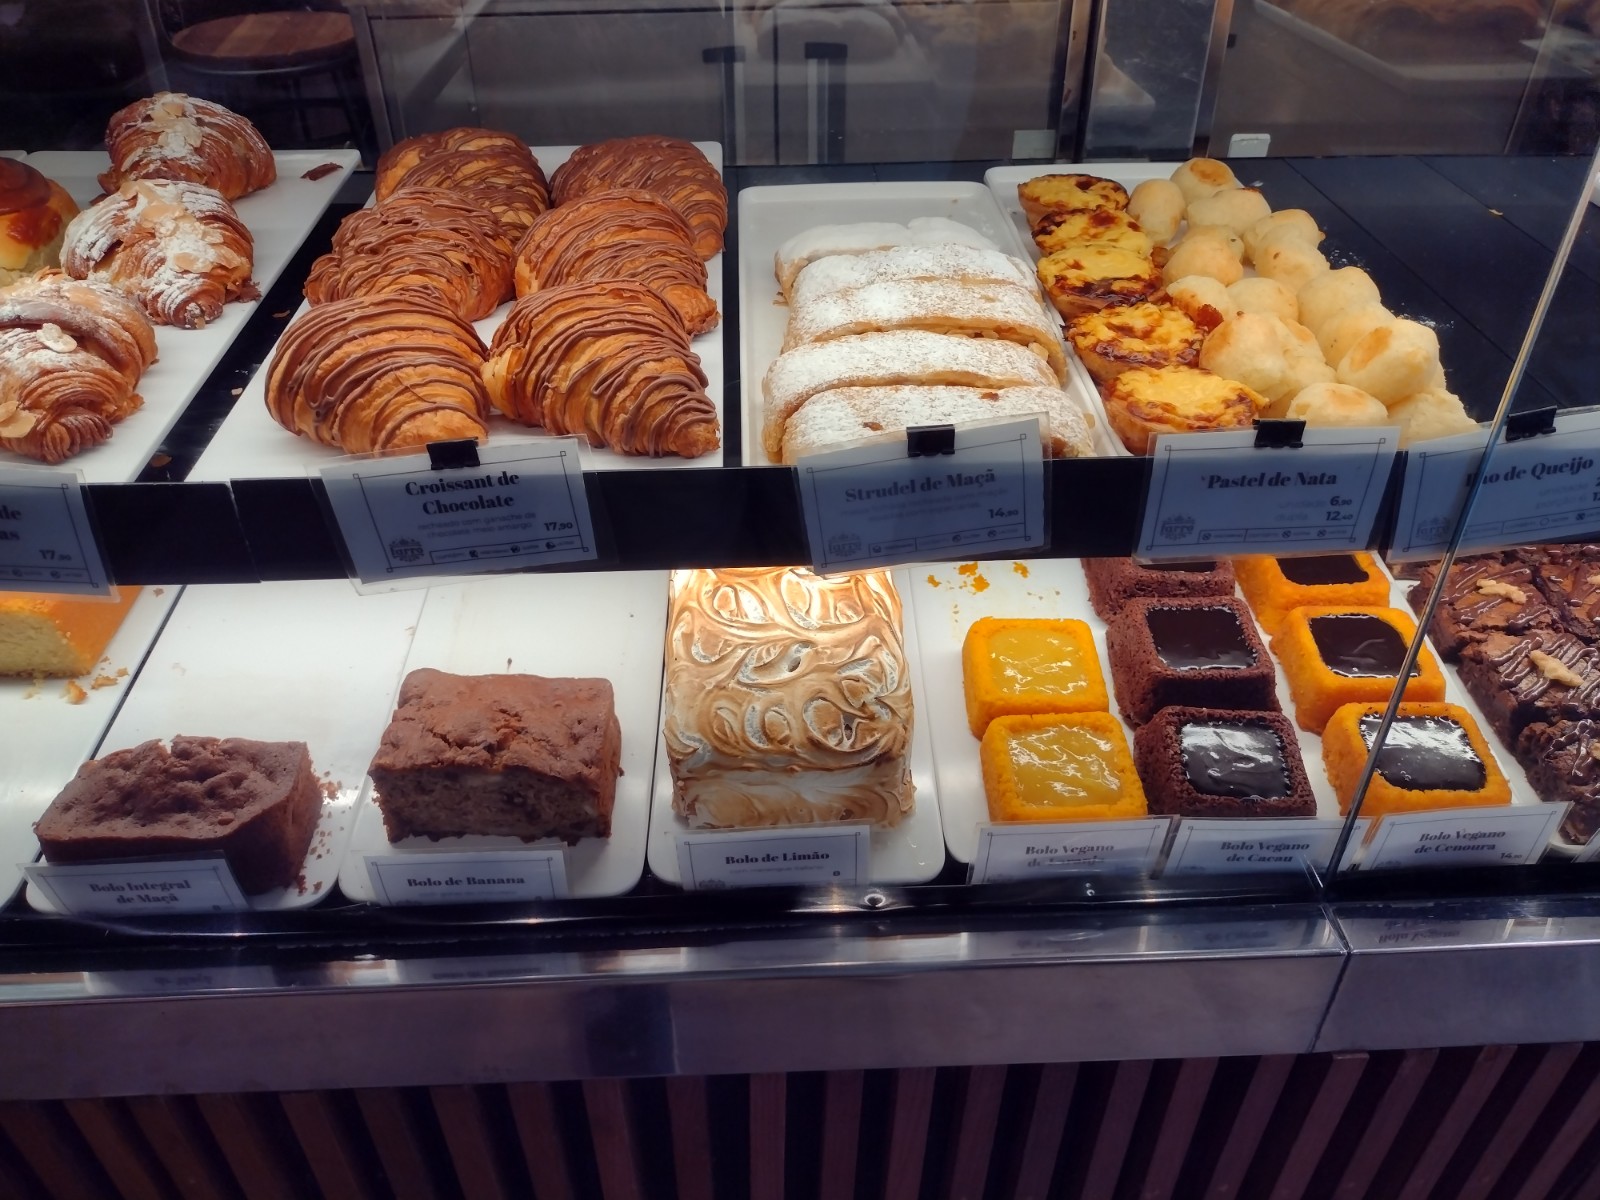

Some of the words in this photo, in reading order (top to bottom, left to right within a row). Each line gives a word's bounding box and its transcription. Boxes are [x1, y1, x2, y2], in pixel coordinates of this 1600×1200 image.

[1504, 466, 1527, 481] de
[1531, 456, 1594, 480] Queijo
[405, 474, 495, 496] Croissant
[498, 471, 520, 486] de
[845, 479, 916, 502] Strudel
[920, 476, 942, 491] de
[946, 468, 996, 489] Maçã
[1207, 471, 1266, 489] Pastel
[1268, 471, 1291, 487] de
[1296, 471, 1337, 486] Nata
[422, 494, 515, 515] Chocolate
[544, 522, 573, 532] 17,90
[1419, 831, 1452, 842] Bolo
[1455, 830, 1507, 843] Vegano
[1025, 845, 1059, 855] Bolo
[1062, 844, 1115, 855] Vegano
[1220, 841, 1255, 851] Bolo
[1258, 842, 1311, 853] Vegano
[1414, 844, 1433, 854] de
[1434, 843, 1497, 854] Cenoura
[725, 854, 759, 864] Bolo
[762, 853, 779, 863] de
[783, 851, 830, 861] Limão
[1226, 853, 1245, 863] de
[1248, 853, 1294, 863] Cacau
[89, 883, 125, 893] Bolo
[128, 879, 191, 892] Integral
[407, 877, 442, 887] Bolo
[445, 877, 463, 886] de
[466, 876, 526, 886] Banana
[116, 894, 135, 904] de
[138, 893, 179, 904] Maçã
